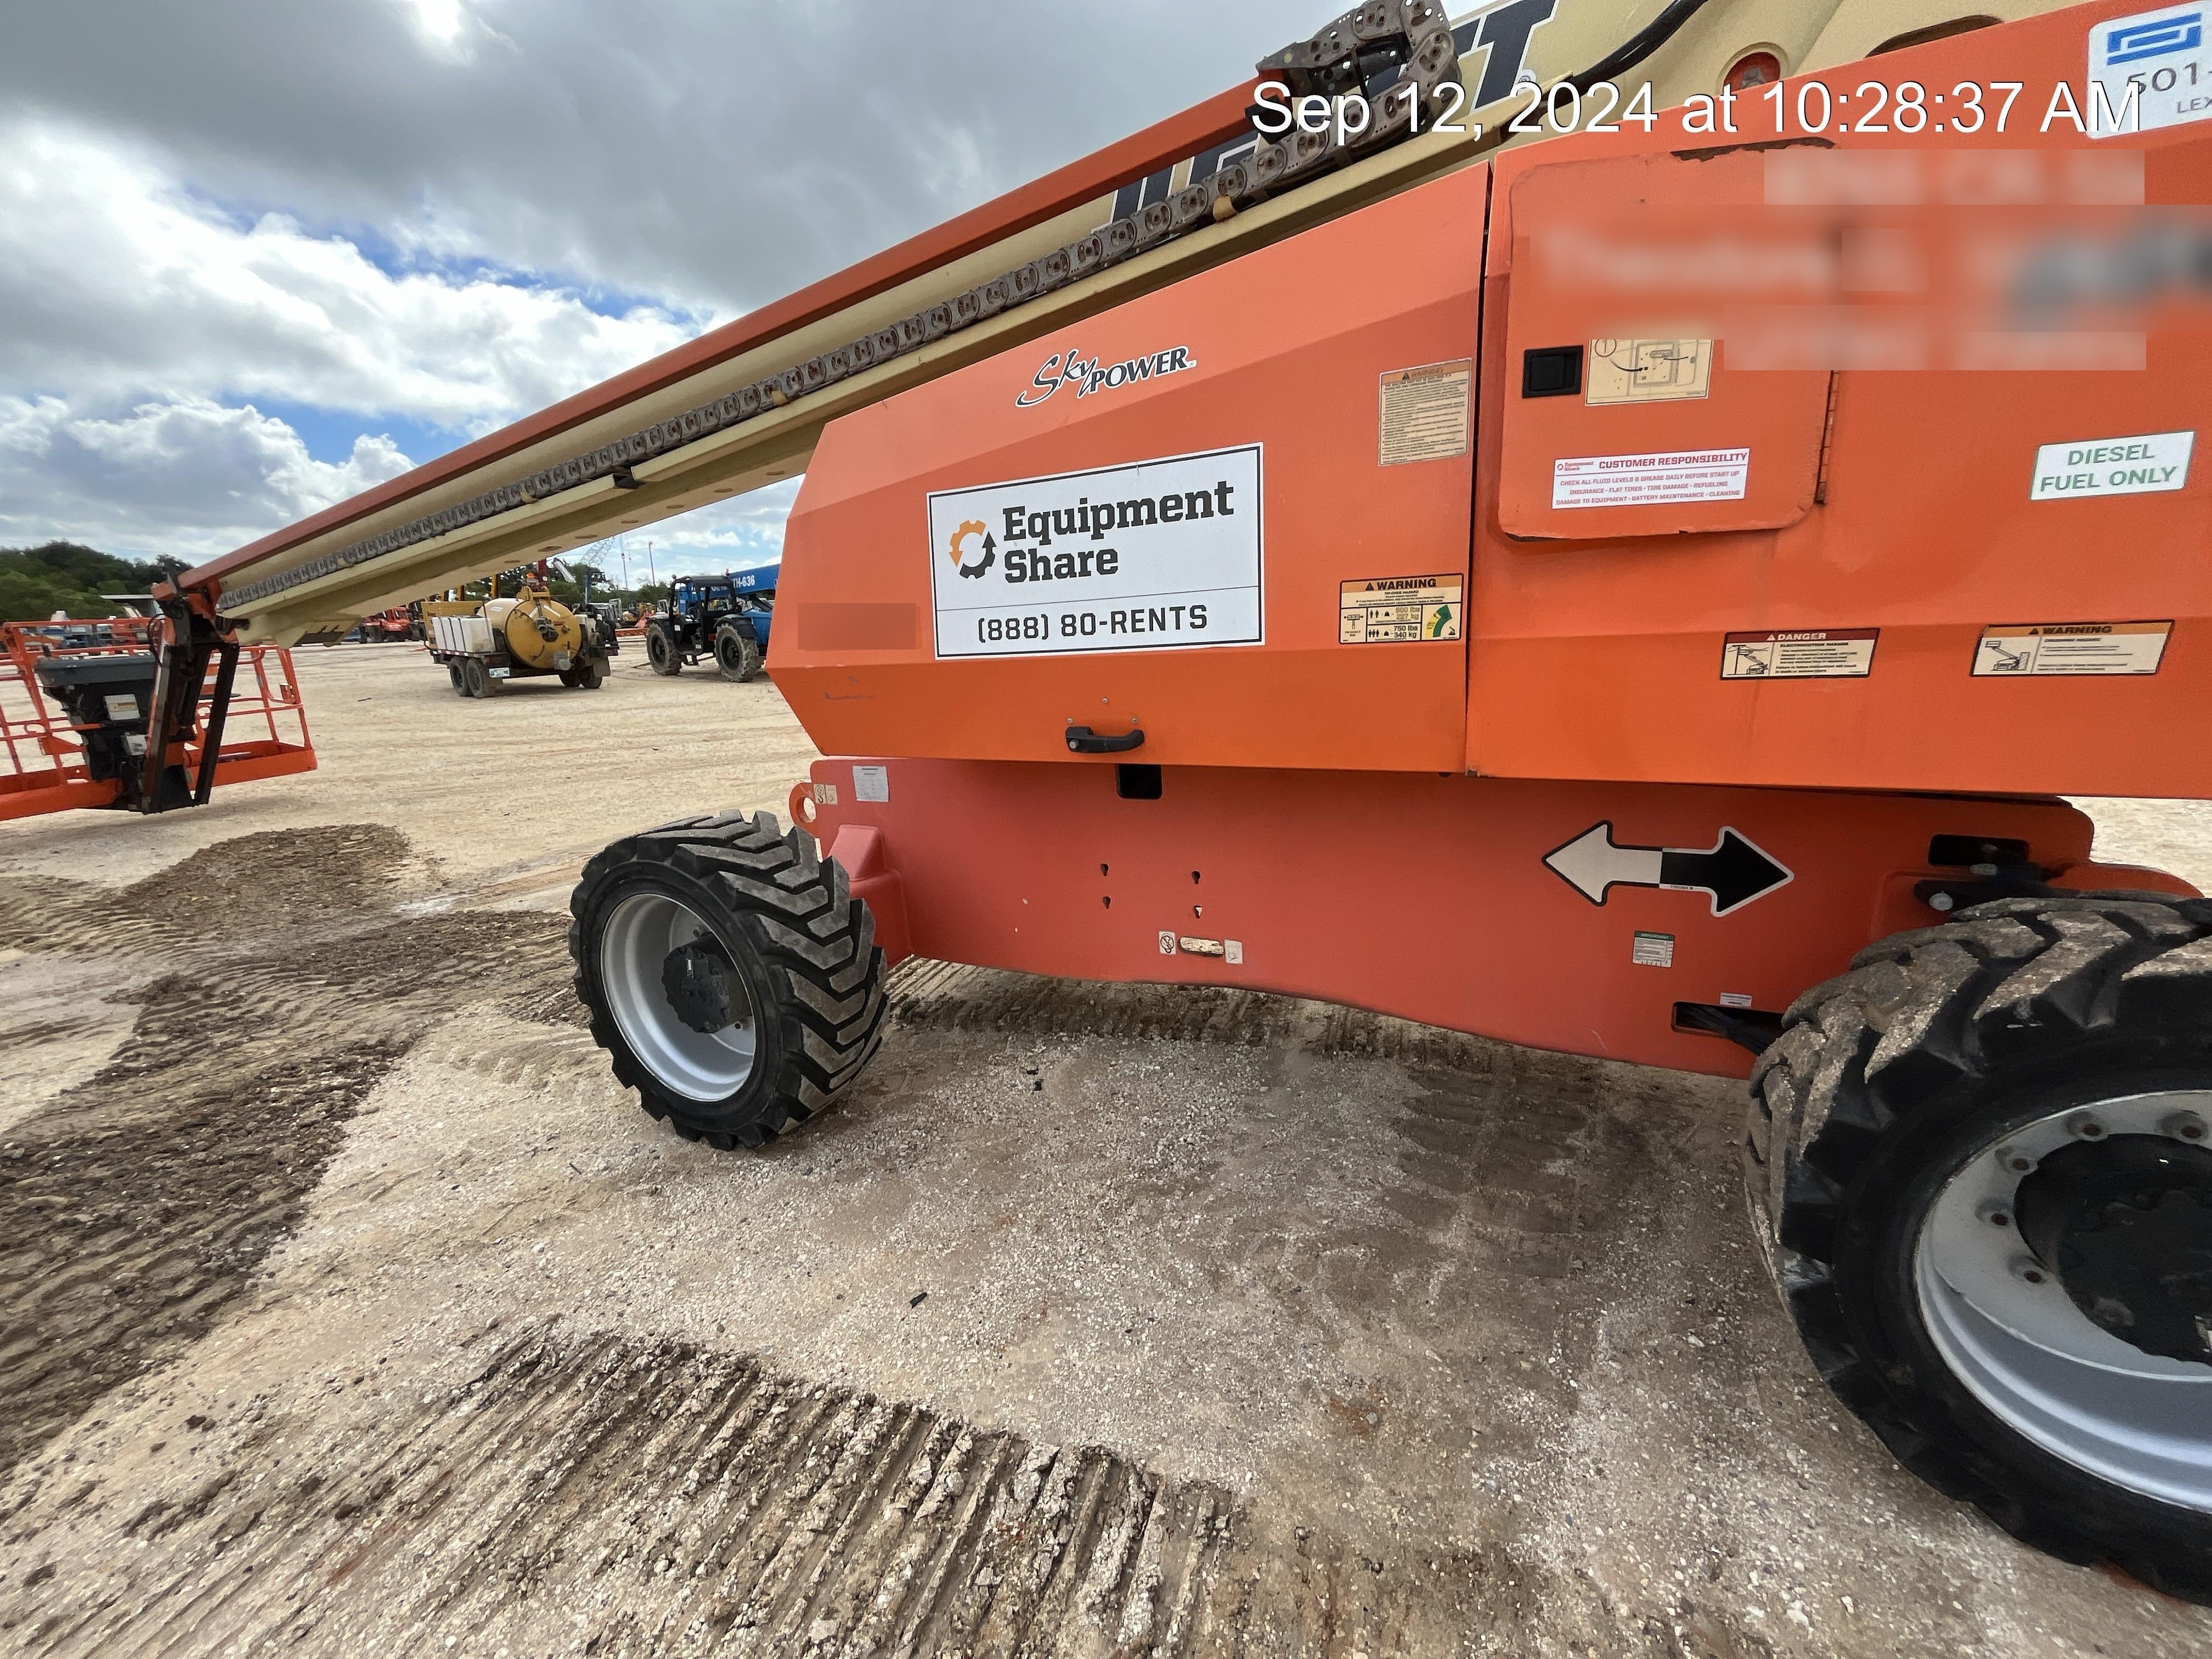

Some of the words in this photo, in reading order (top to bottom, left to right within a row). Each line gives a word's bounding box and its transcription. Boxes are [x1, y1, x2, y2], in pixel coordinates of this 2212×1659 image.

[1599, 459, 1656, 469] CUSTOMER
[1658, 453, 1747, 465] RESPONSIBILITY
[2068, 444, 2155, 465] DIESEL
[2041, 473, 2100, 492] FUEL
[2109, 466, 2178, 486] ONLY
[1003, 481, 1234, 545] Equipment
[1004, 548, 1118, 583] Share
[1377, 578, 1436, 590] WARNING
[978, 614, 1048, 643] (888)
[1061, 605, 1207, 636] 80-RENTS
[2043, 625, 2112, 634] WARNING
